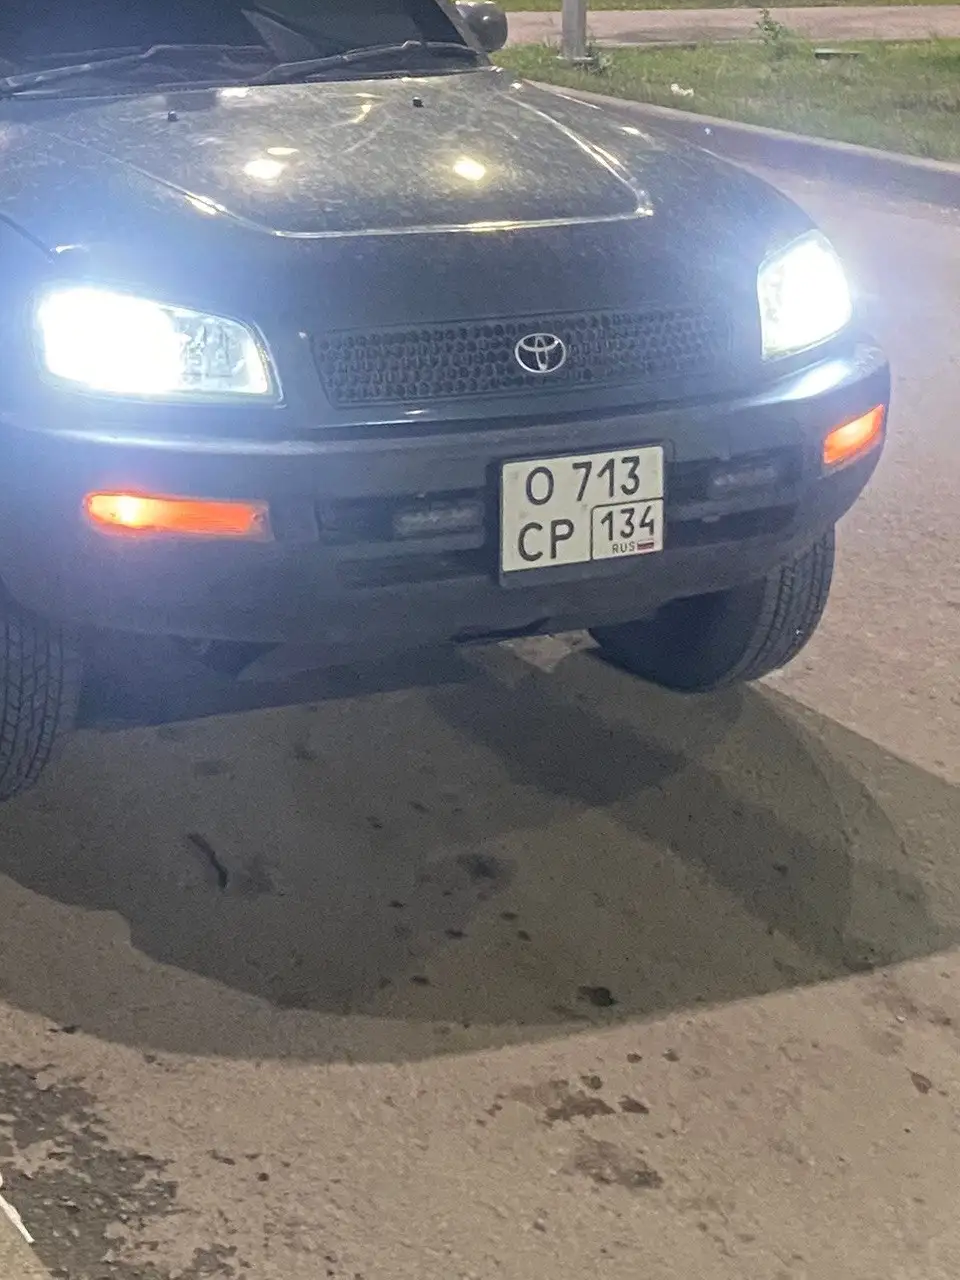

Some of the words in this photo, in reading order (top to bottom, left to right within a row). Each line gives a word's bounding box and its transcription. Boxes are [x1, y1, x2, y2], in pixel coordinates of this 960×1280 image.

[572, 456, 640, 502] 713
[600, 505, 655, 541] 134
[612, 541, 635, 554] RUS
